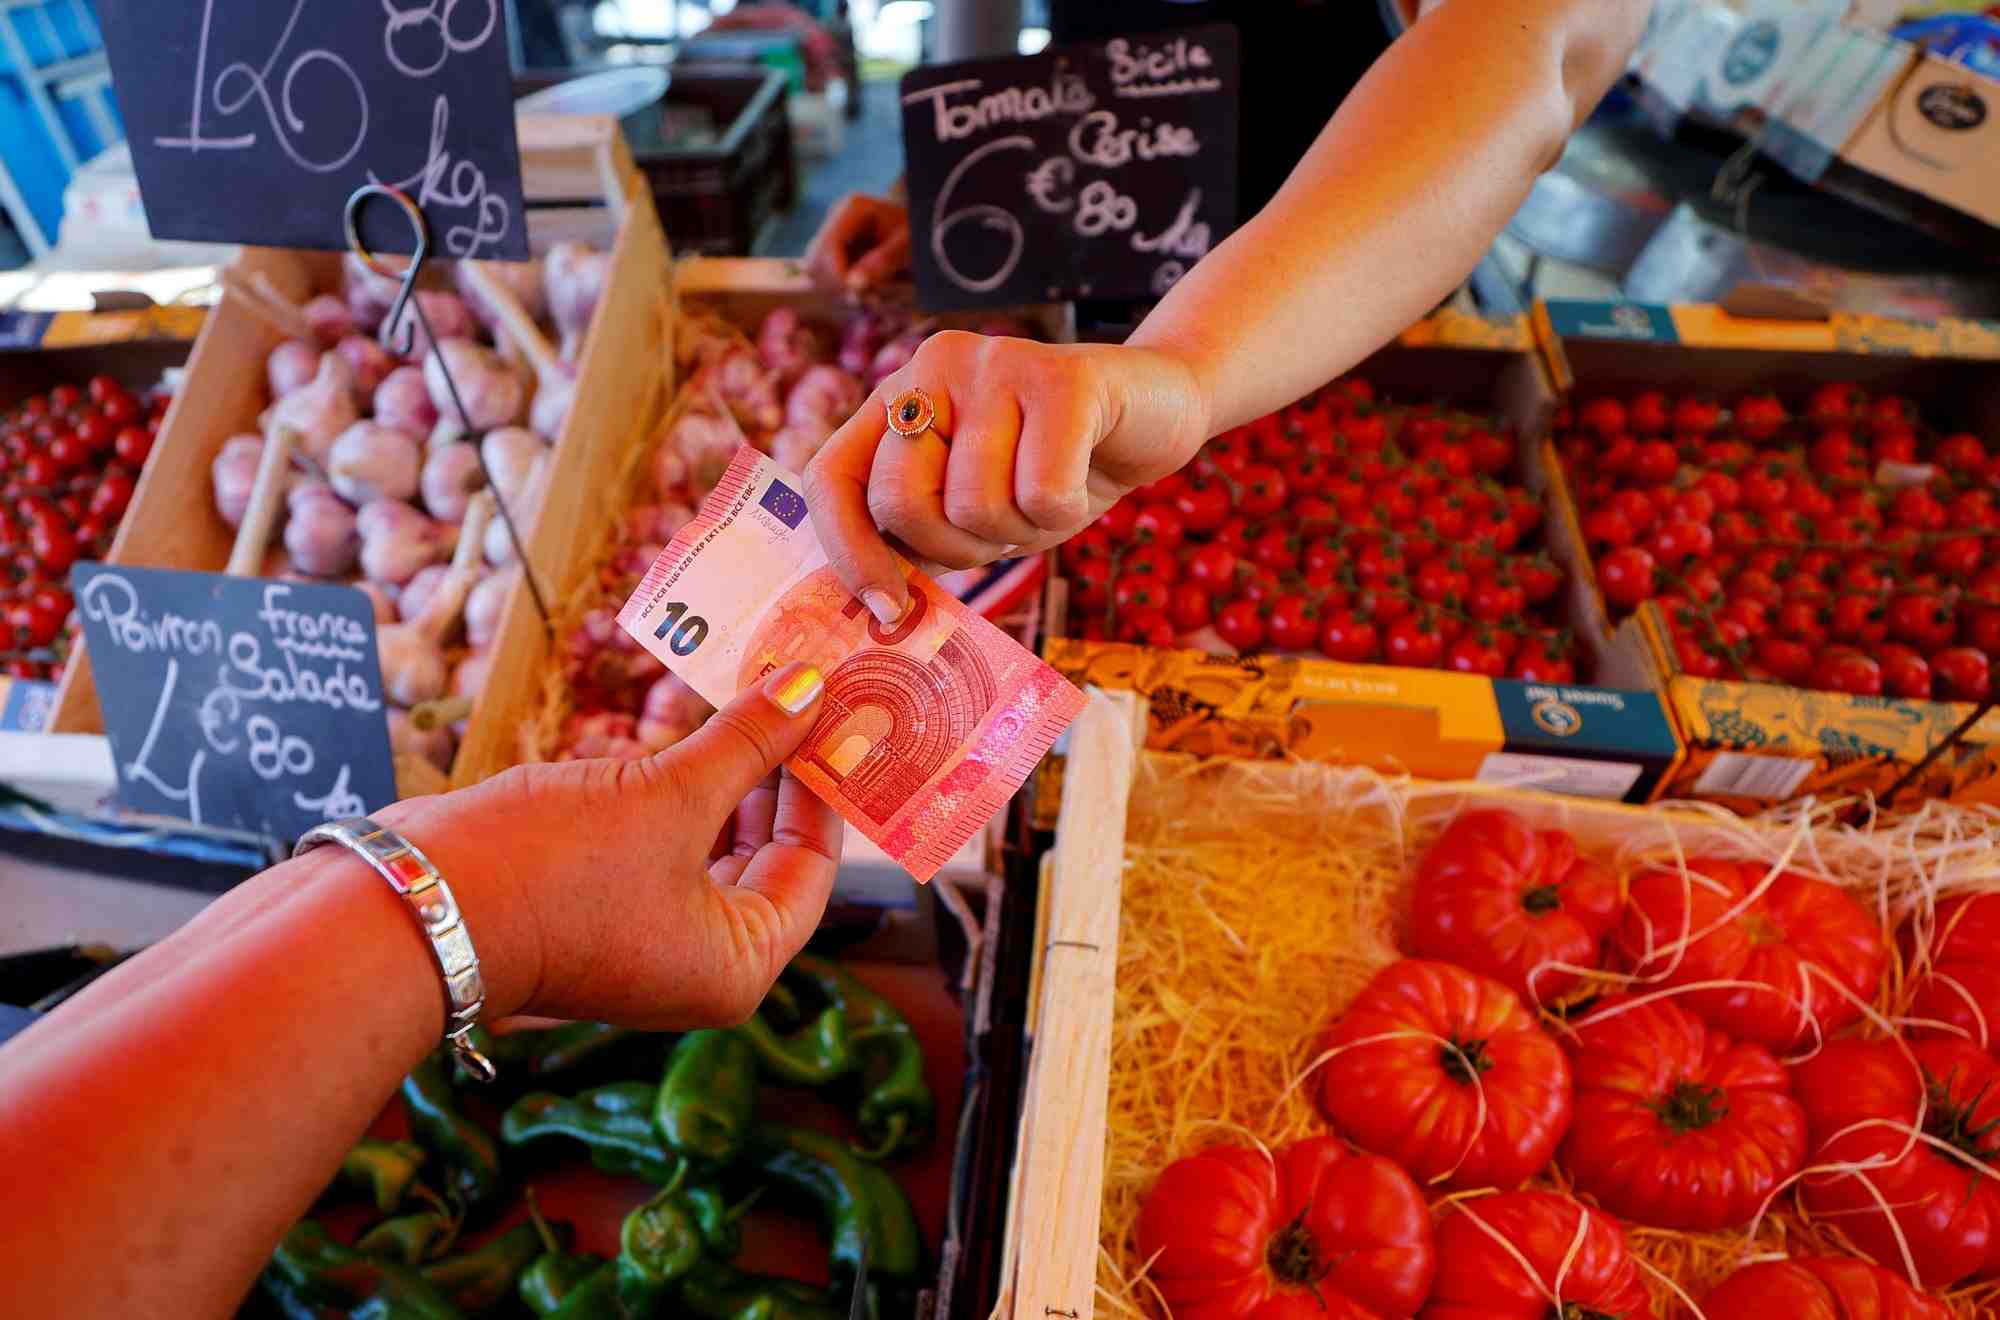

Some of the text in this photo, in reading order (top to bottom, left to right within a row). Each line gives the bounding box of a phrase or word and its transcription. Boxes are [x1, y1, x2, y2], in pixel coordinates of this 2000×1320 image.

[1105, 37, 1213, 85] Sicile
[1068, 110, 1201, 168] Cerise
[366, 94, 510, 259] kg
[931, 134, 1037, 292] 6
[1074, 180, 1138, 237] 80
[81, 573, 223, 655] Poivron
[258, 584, 368, 645] France
[653, 602, 709, 656] 10
[217, 632, 380, 711] Salade
[247, 714, 316, 781] 80
